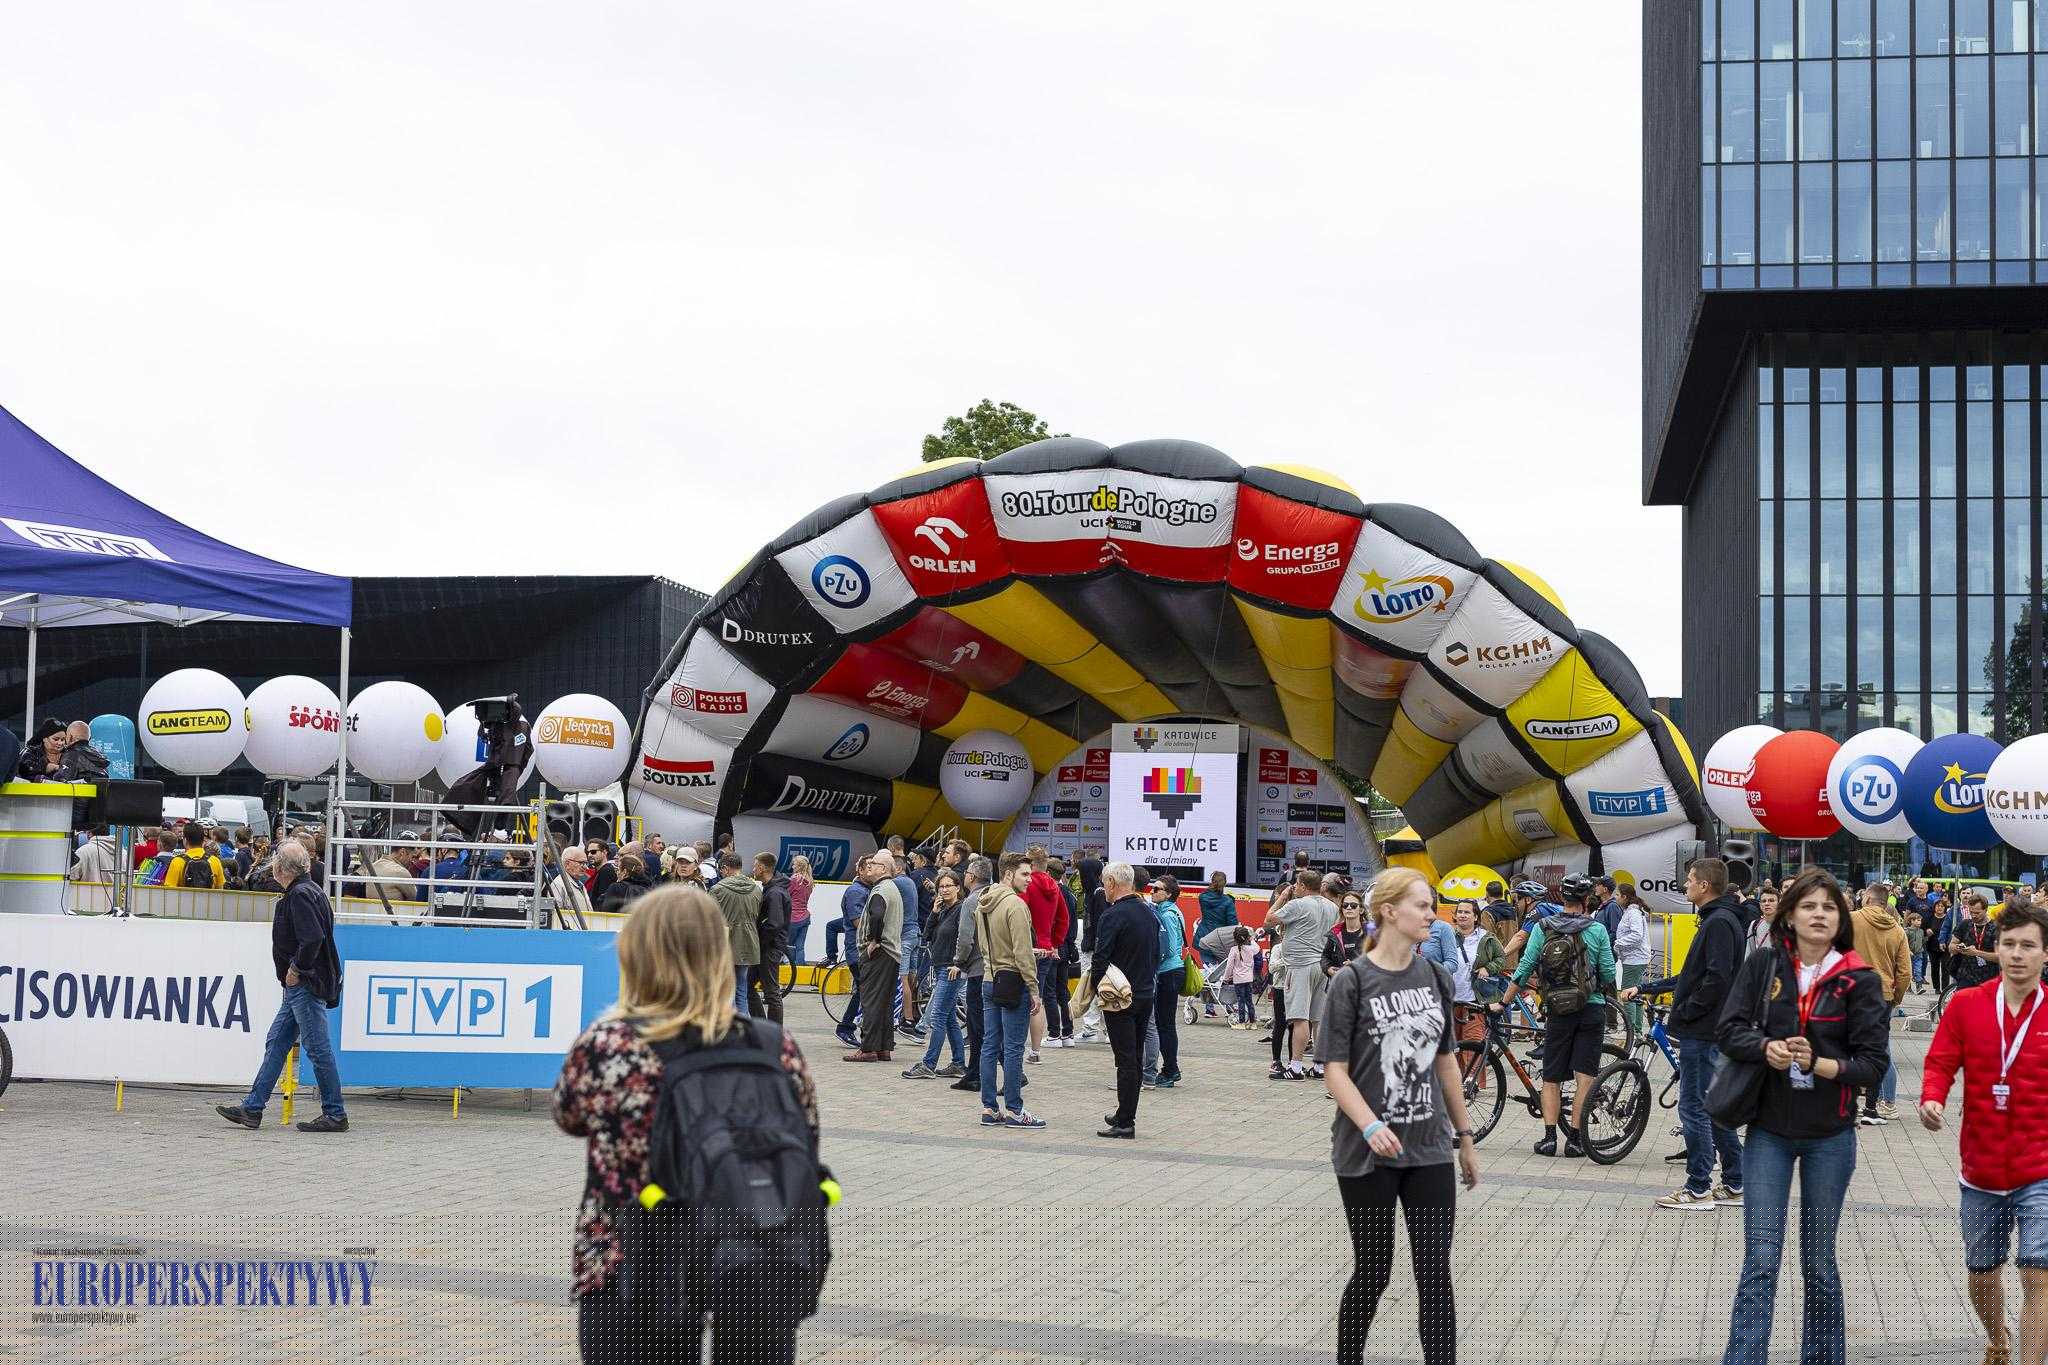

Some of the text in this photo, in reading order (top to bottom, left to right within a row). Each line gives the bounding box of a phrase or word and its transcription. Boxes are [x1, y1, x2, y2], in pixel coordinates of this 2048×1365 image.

[1080, 519, 1137, 528] UCI WORLD
[1265, 542, 1339, 561] Energa
[909, 555, 976, 573] ORLEN
[1266, 560, 1339, 575] GRUPA ORLEN
[824, 572, 857, 595] PZU
[1371, 585, 1434, 616] LOTTO
[744, 630, 814, 644] DRUTEX
[1477, 636, 1552, 661] KGHM
[700, 694, 742, 703] POLSKIE
[885, 687, 928, 709] Energa
[700, 703, 743, 711] RADIO
[152, 716, 226, 728] LANGTEAM
[566, 718, 611, 737] Jedynka
[1532, 721, 1612, 735] LANGTEAM
[591, 739, 608, 747] RADIO
[1164, 731, 1217, 740] KATOWICE
[643, 768, 716, 787] SOUDAL
[965, 770, 980, 778] UCI
[1852, 776, 1891, 806] PZU
[801, 788, 878, 816] DRUTEX
[1597, 792, 1658, 812] TVP 1
[1125, 837, 1218, 852] KATOWICE
[1144, 856, 1198, 865] dla odmiany
[1640, 879, 1685, 894] one
[374, 976, 552, 1038] TVP 1
[1369, 986, 1437, 1021] BLONDIE
